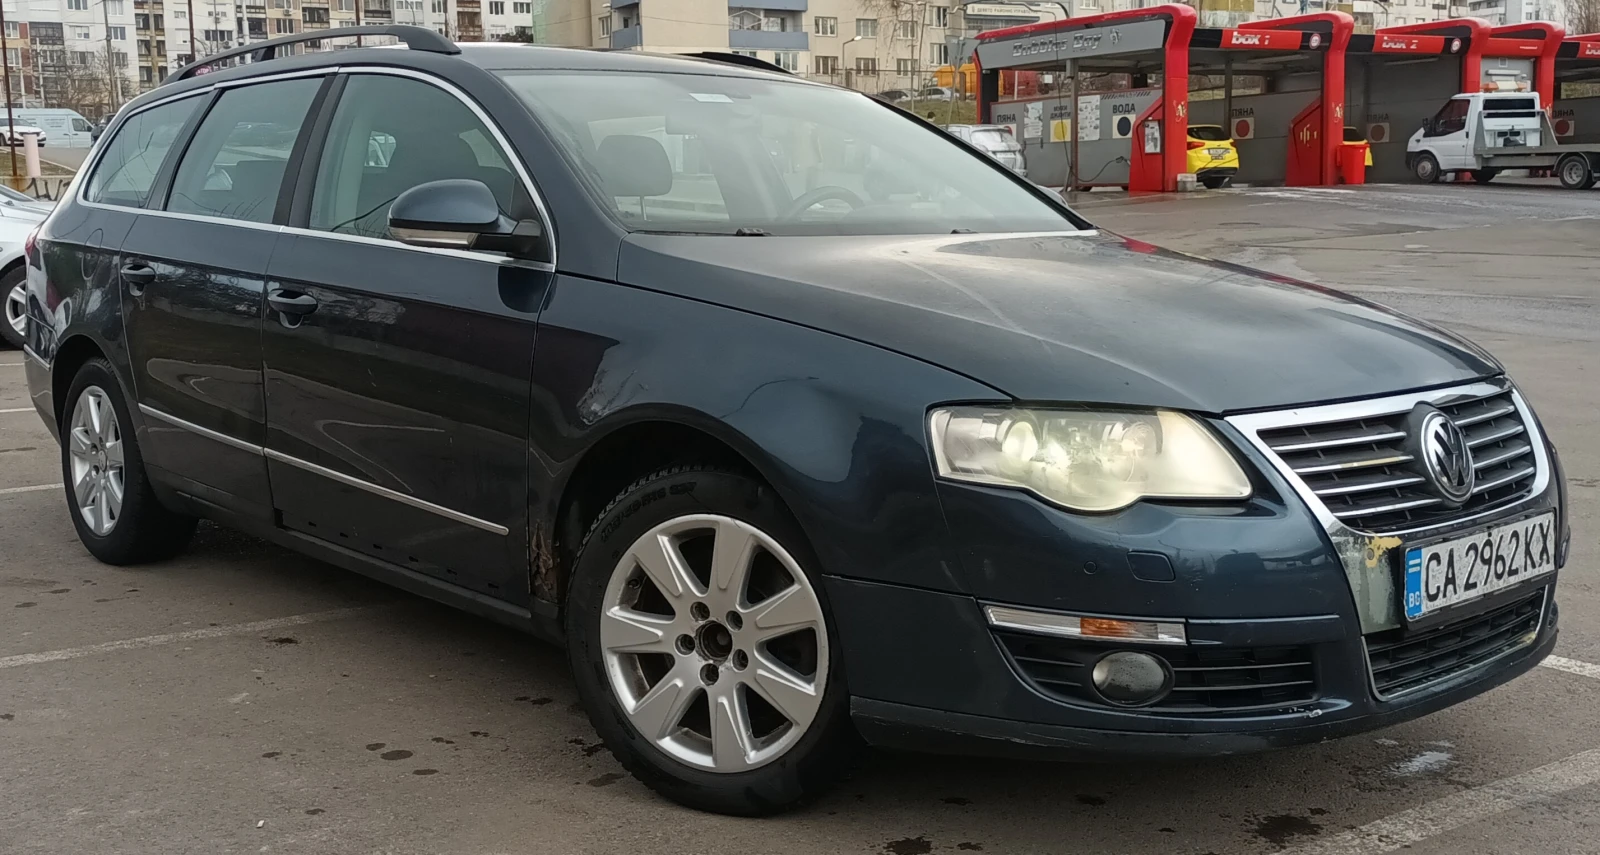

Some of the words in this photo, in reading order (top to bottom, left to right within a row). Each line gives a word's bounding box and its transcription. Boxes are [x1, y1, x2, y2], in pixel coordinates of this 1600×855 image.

[1231, 31, 1261, 45] box
[1112, 103, 1136, 115] ВОДА
[1231, 107, 1254, 117] ПЯНА
[996, 113, 1016, 124] ПЯНА
[1463, 531, 1518, 591] 2962
[1408, 591, 1421, 608] BG
